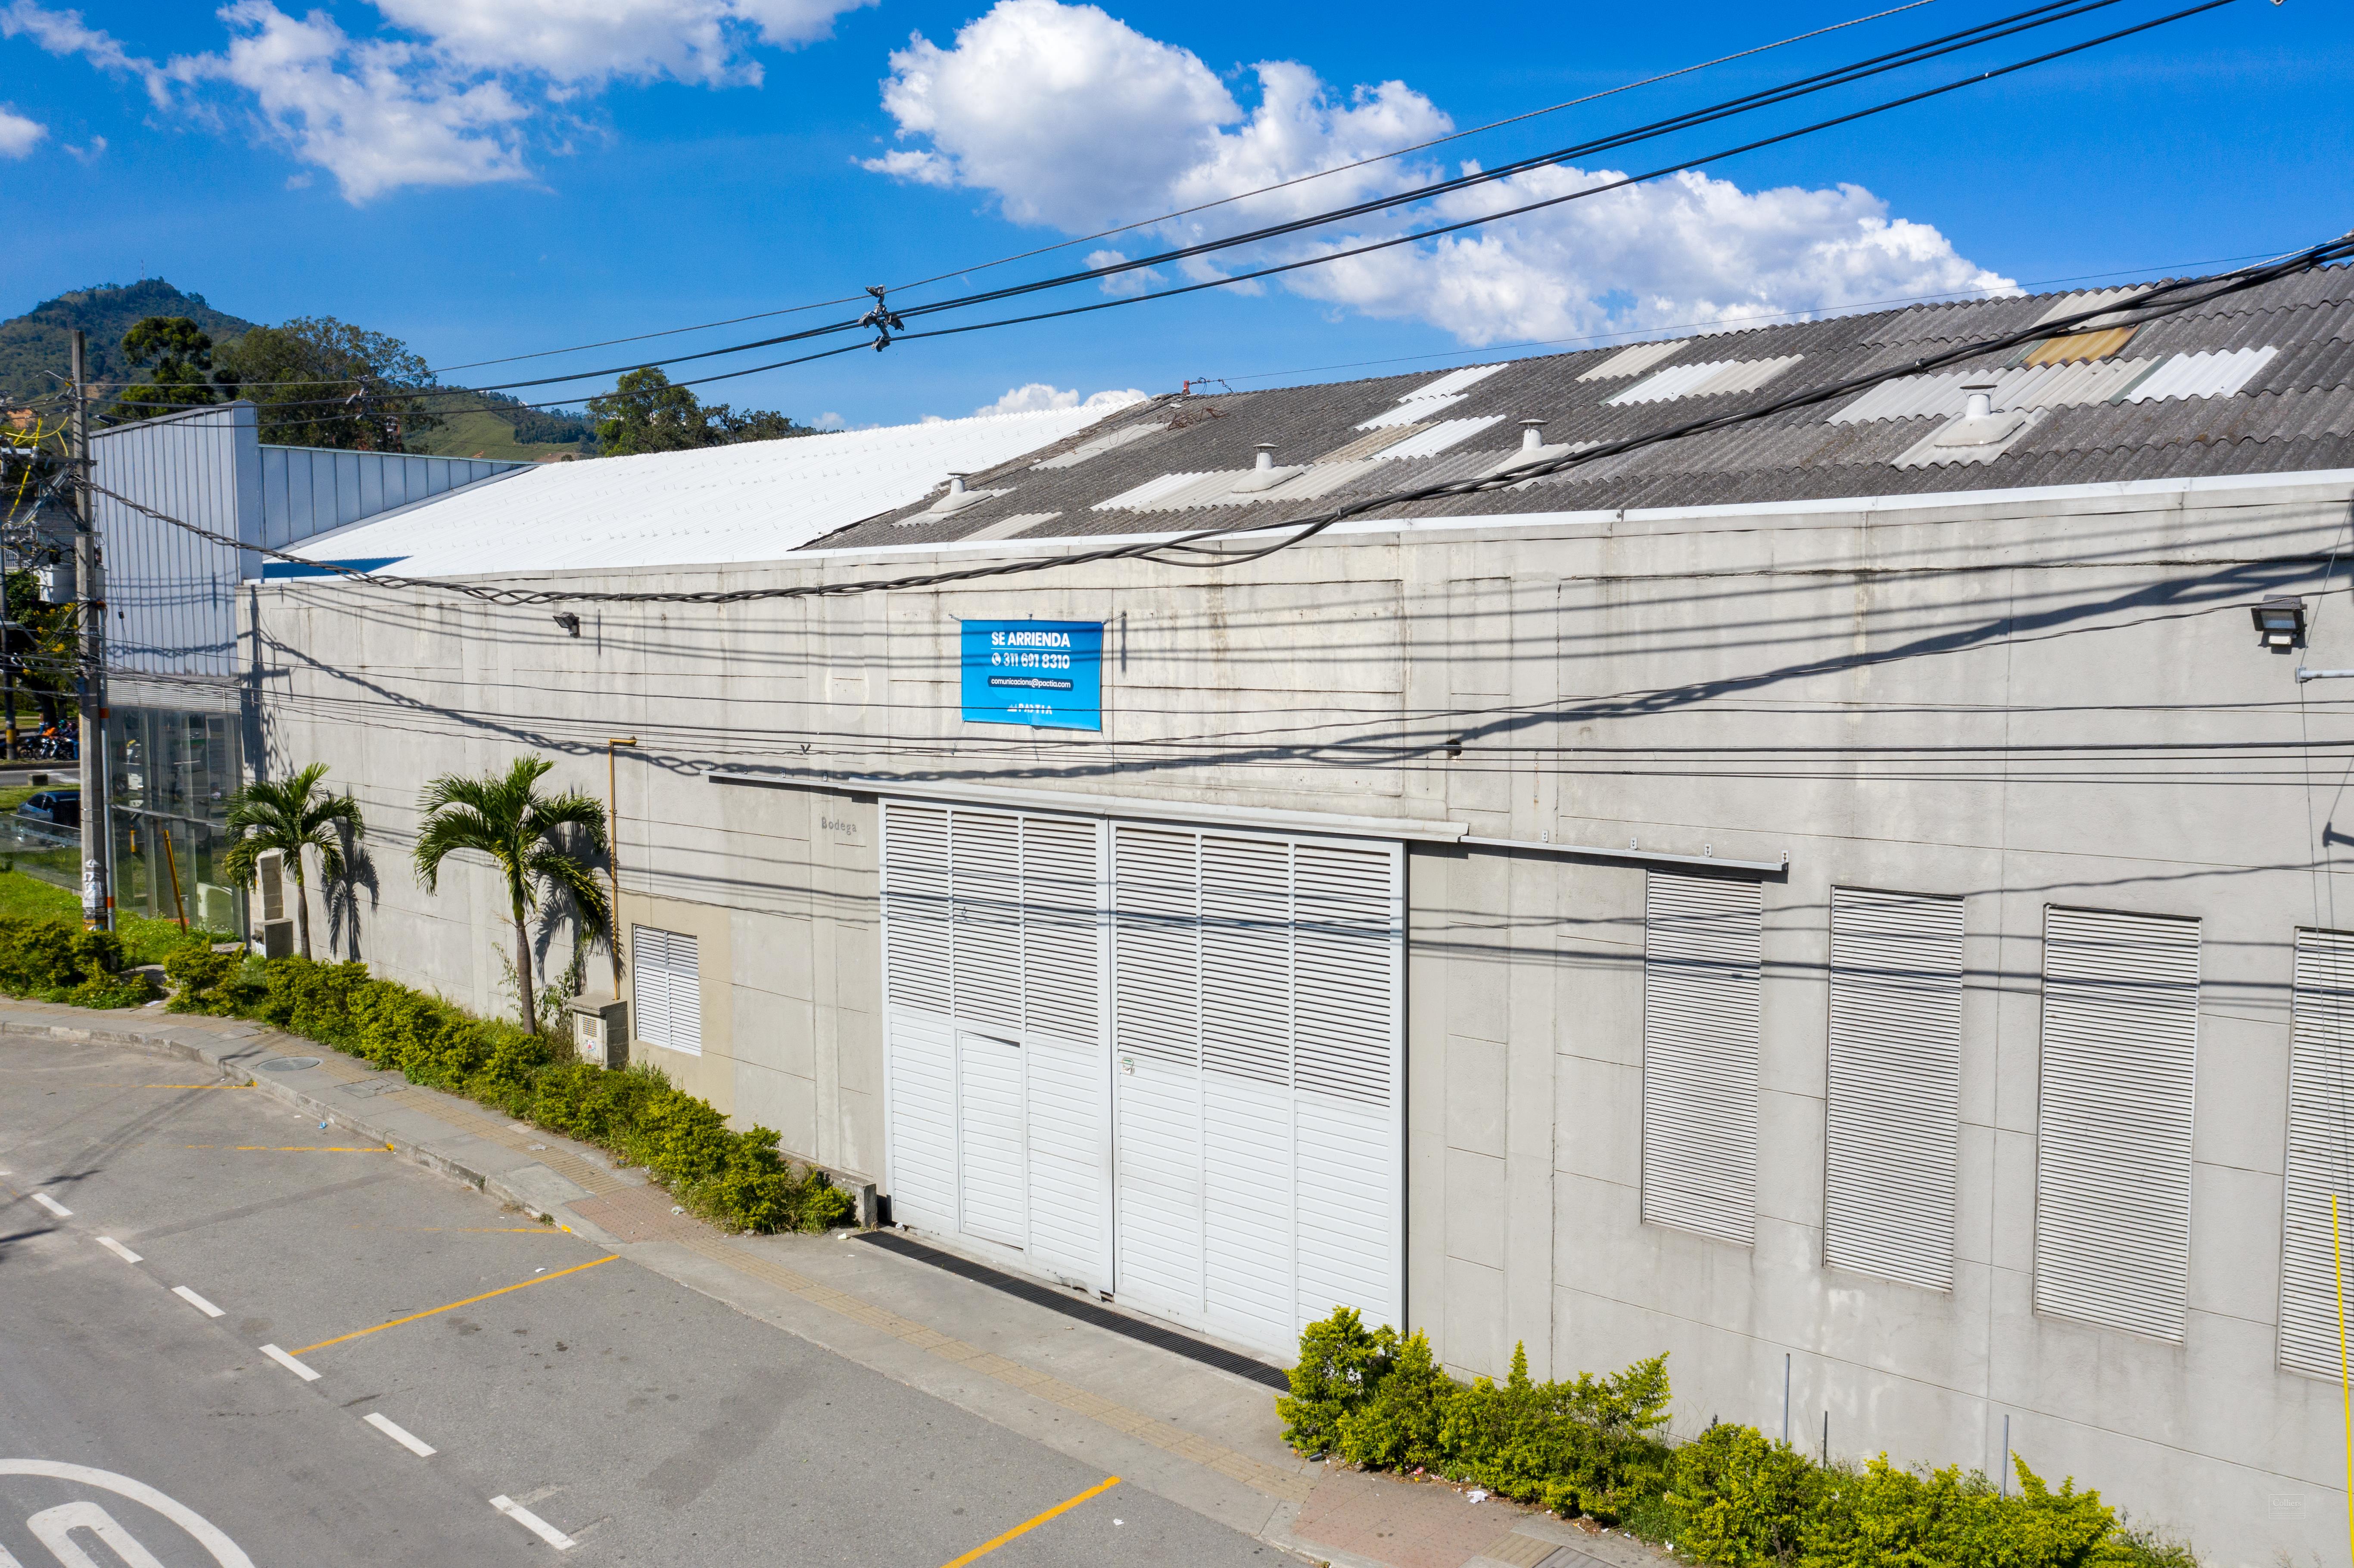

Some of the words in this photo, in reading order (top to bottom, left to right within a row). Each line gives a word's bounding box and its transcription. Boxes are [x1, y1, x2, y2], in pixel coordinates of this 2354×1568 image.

[991, 632, 1006, 645] SE
[1007, 632, 1071, 647] ARRIENDA
[1003, 652, 1018, 666] 311
[1021, 653, 1039, 668] 691
[1042, 653, 1070, 669] 8310
[991, 678, 1071, 688] comunicacions@pactia.com
[821, 817, 857, 836] Bodega
